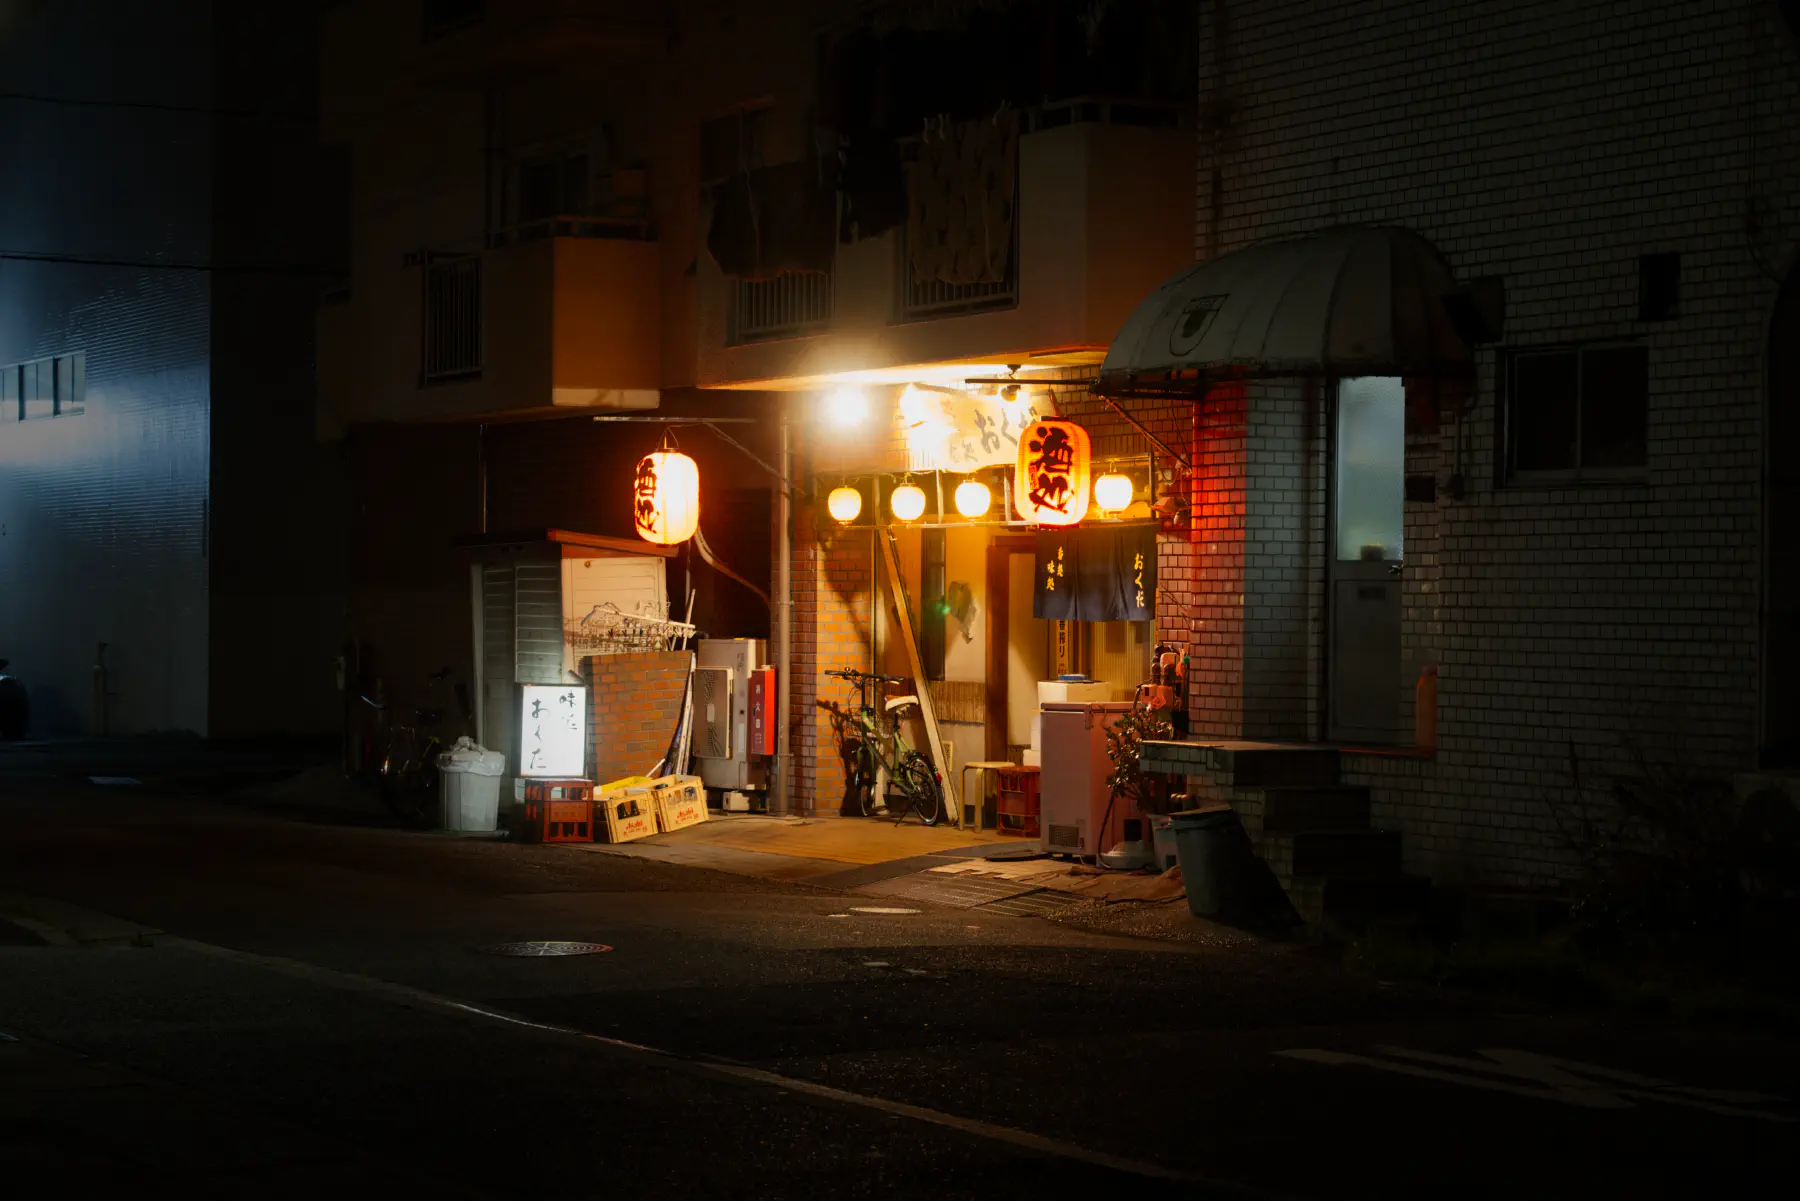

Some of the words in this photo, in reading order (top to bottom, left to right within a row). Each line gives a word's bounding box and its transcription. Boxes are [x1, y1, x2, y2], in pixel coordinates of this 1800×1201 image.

[1027, 426, 1075, 515] 酒処
[1133, 552, 1145, 608] おくだ
